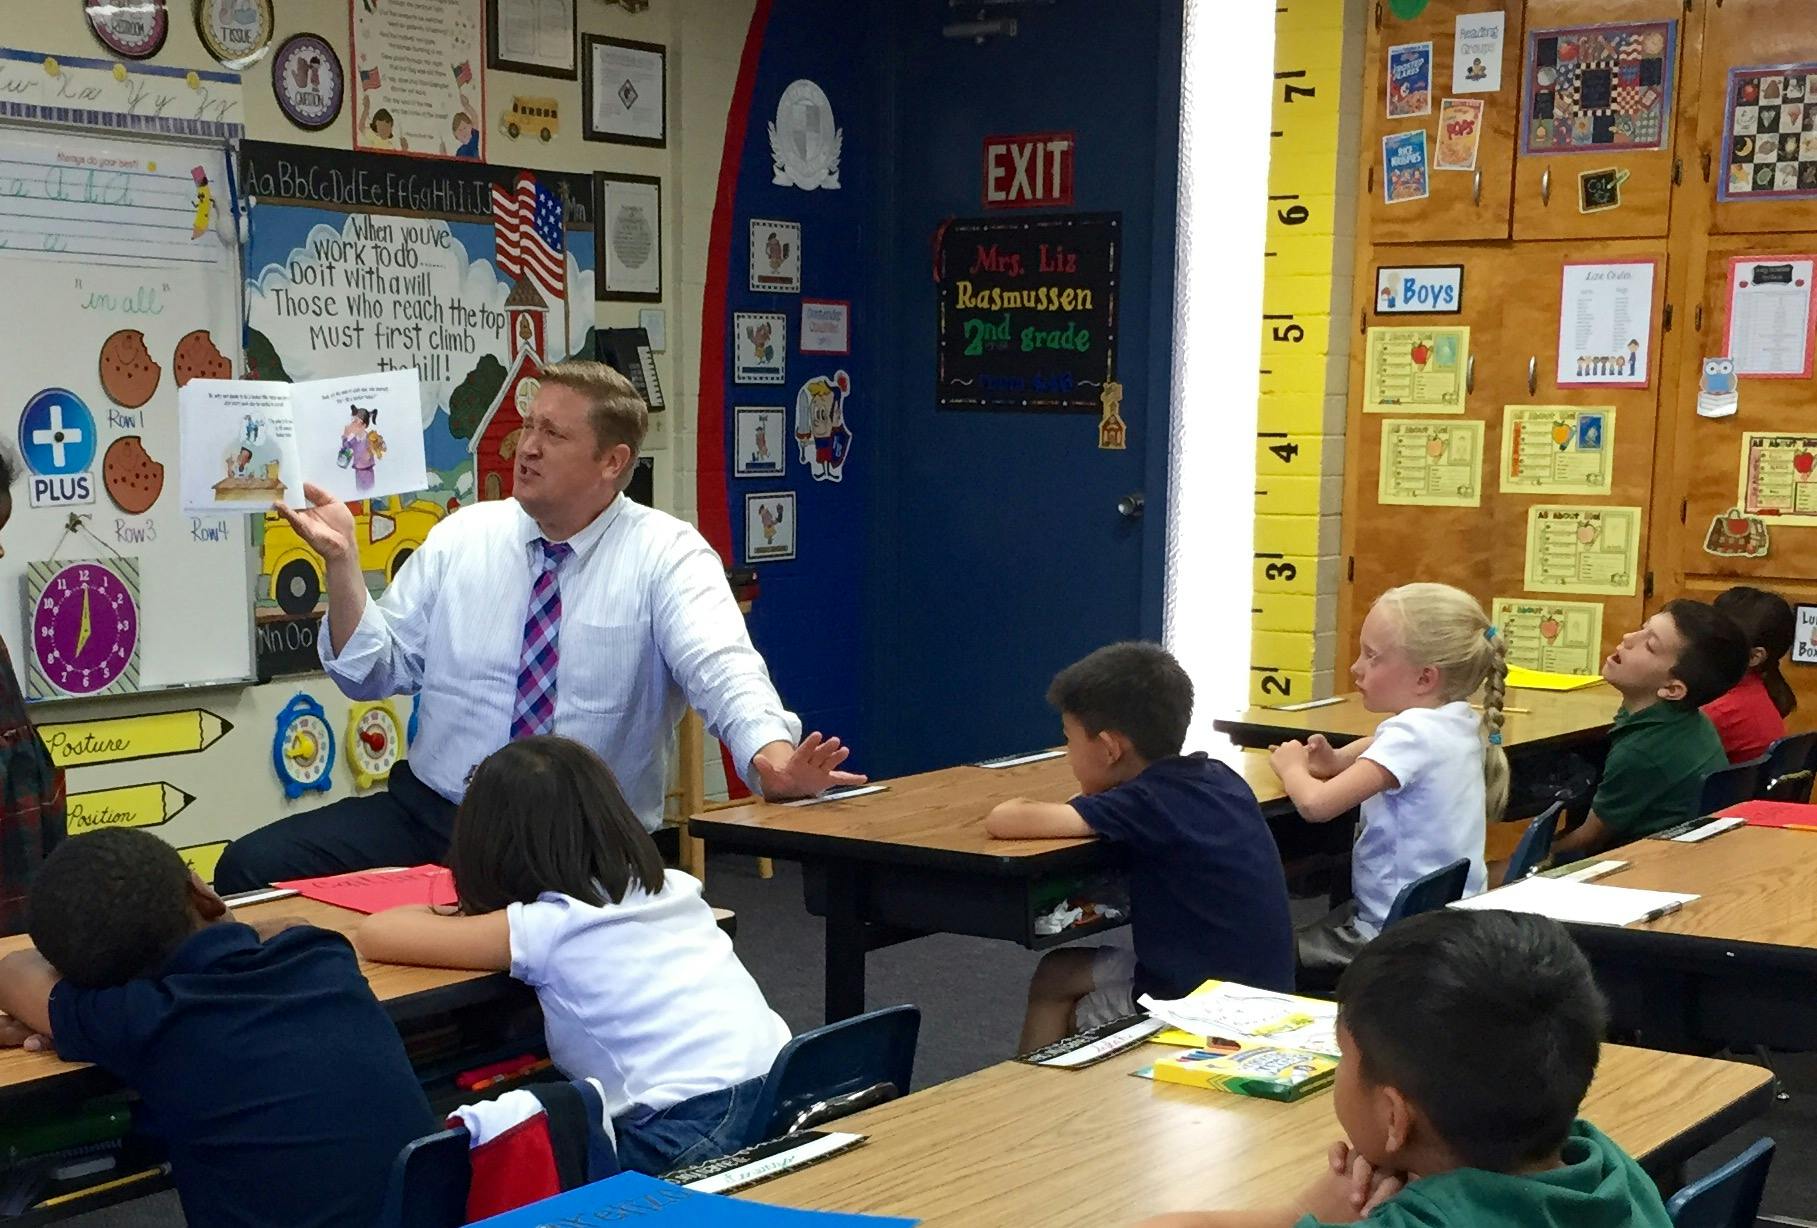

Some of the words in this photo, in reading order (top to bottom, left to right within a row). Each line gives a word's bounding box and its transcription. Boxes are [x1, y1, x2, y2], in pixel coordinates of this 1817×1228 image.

[1284, 84, 1316, 103] 7
[987, 141, 1069, 201] EXIT
[1277, 205, 1309, 226] 6
[352, 214, 393, 244] When
[371, 243, 391, 267] to
[1039, 243, 1077, 273] Liz
[290, 261, 317, 286] Do
[320, 261, 336, 288] it
[390, 275, 401, 296] a
[404, 271, 432, 298] will
[956, 281, 1093, 312] Rasmussen
[1403, 277, 1454, 309] Boys
[271, 288, 338, 317] Those
[393, 295, 443, 324] reach
[449, 297, 477, 328] the
[479, 302, 505, 340] top
[375, 322, 422, 352] first
[429, 325, 475, 354] climb
[963, 313, 1011, 356] 2nd
[1021, 321, 1090, 352] grade
[1273, 324, 1304, 343] 5
[1269, 443, 1299, 464] 4
[35, 477, 90, 502] PLUS
[79, 570, 90, 581] 12
[103, 576, 108, 587] 1
[1265, 562, 1297, 582] 3
[57, 579, 67, 590] 11
[44, 597, 54, 610] 10
[117, 593, 124, 605] 2
[123, 620, 130, 632] 3
[1803, 611, 1817, 626] Lu
[41, 626, 48, 637] 9
[47, 652, 55, 665] 8
[118, 647, 125, 658] 4
[61, 672, 67, 682] 7
[83, 677, 89, 687] 6
[103, 667, 110, 679] 5
[1261, 675, 1292, 697] 2
[46, 732, 130, 757] Posture
[66, 803, 136, 827] Position
